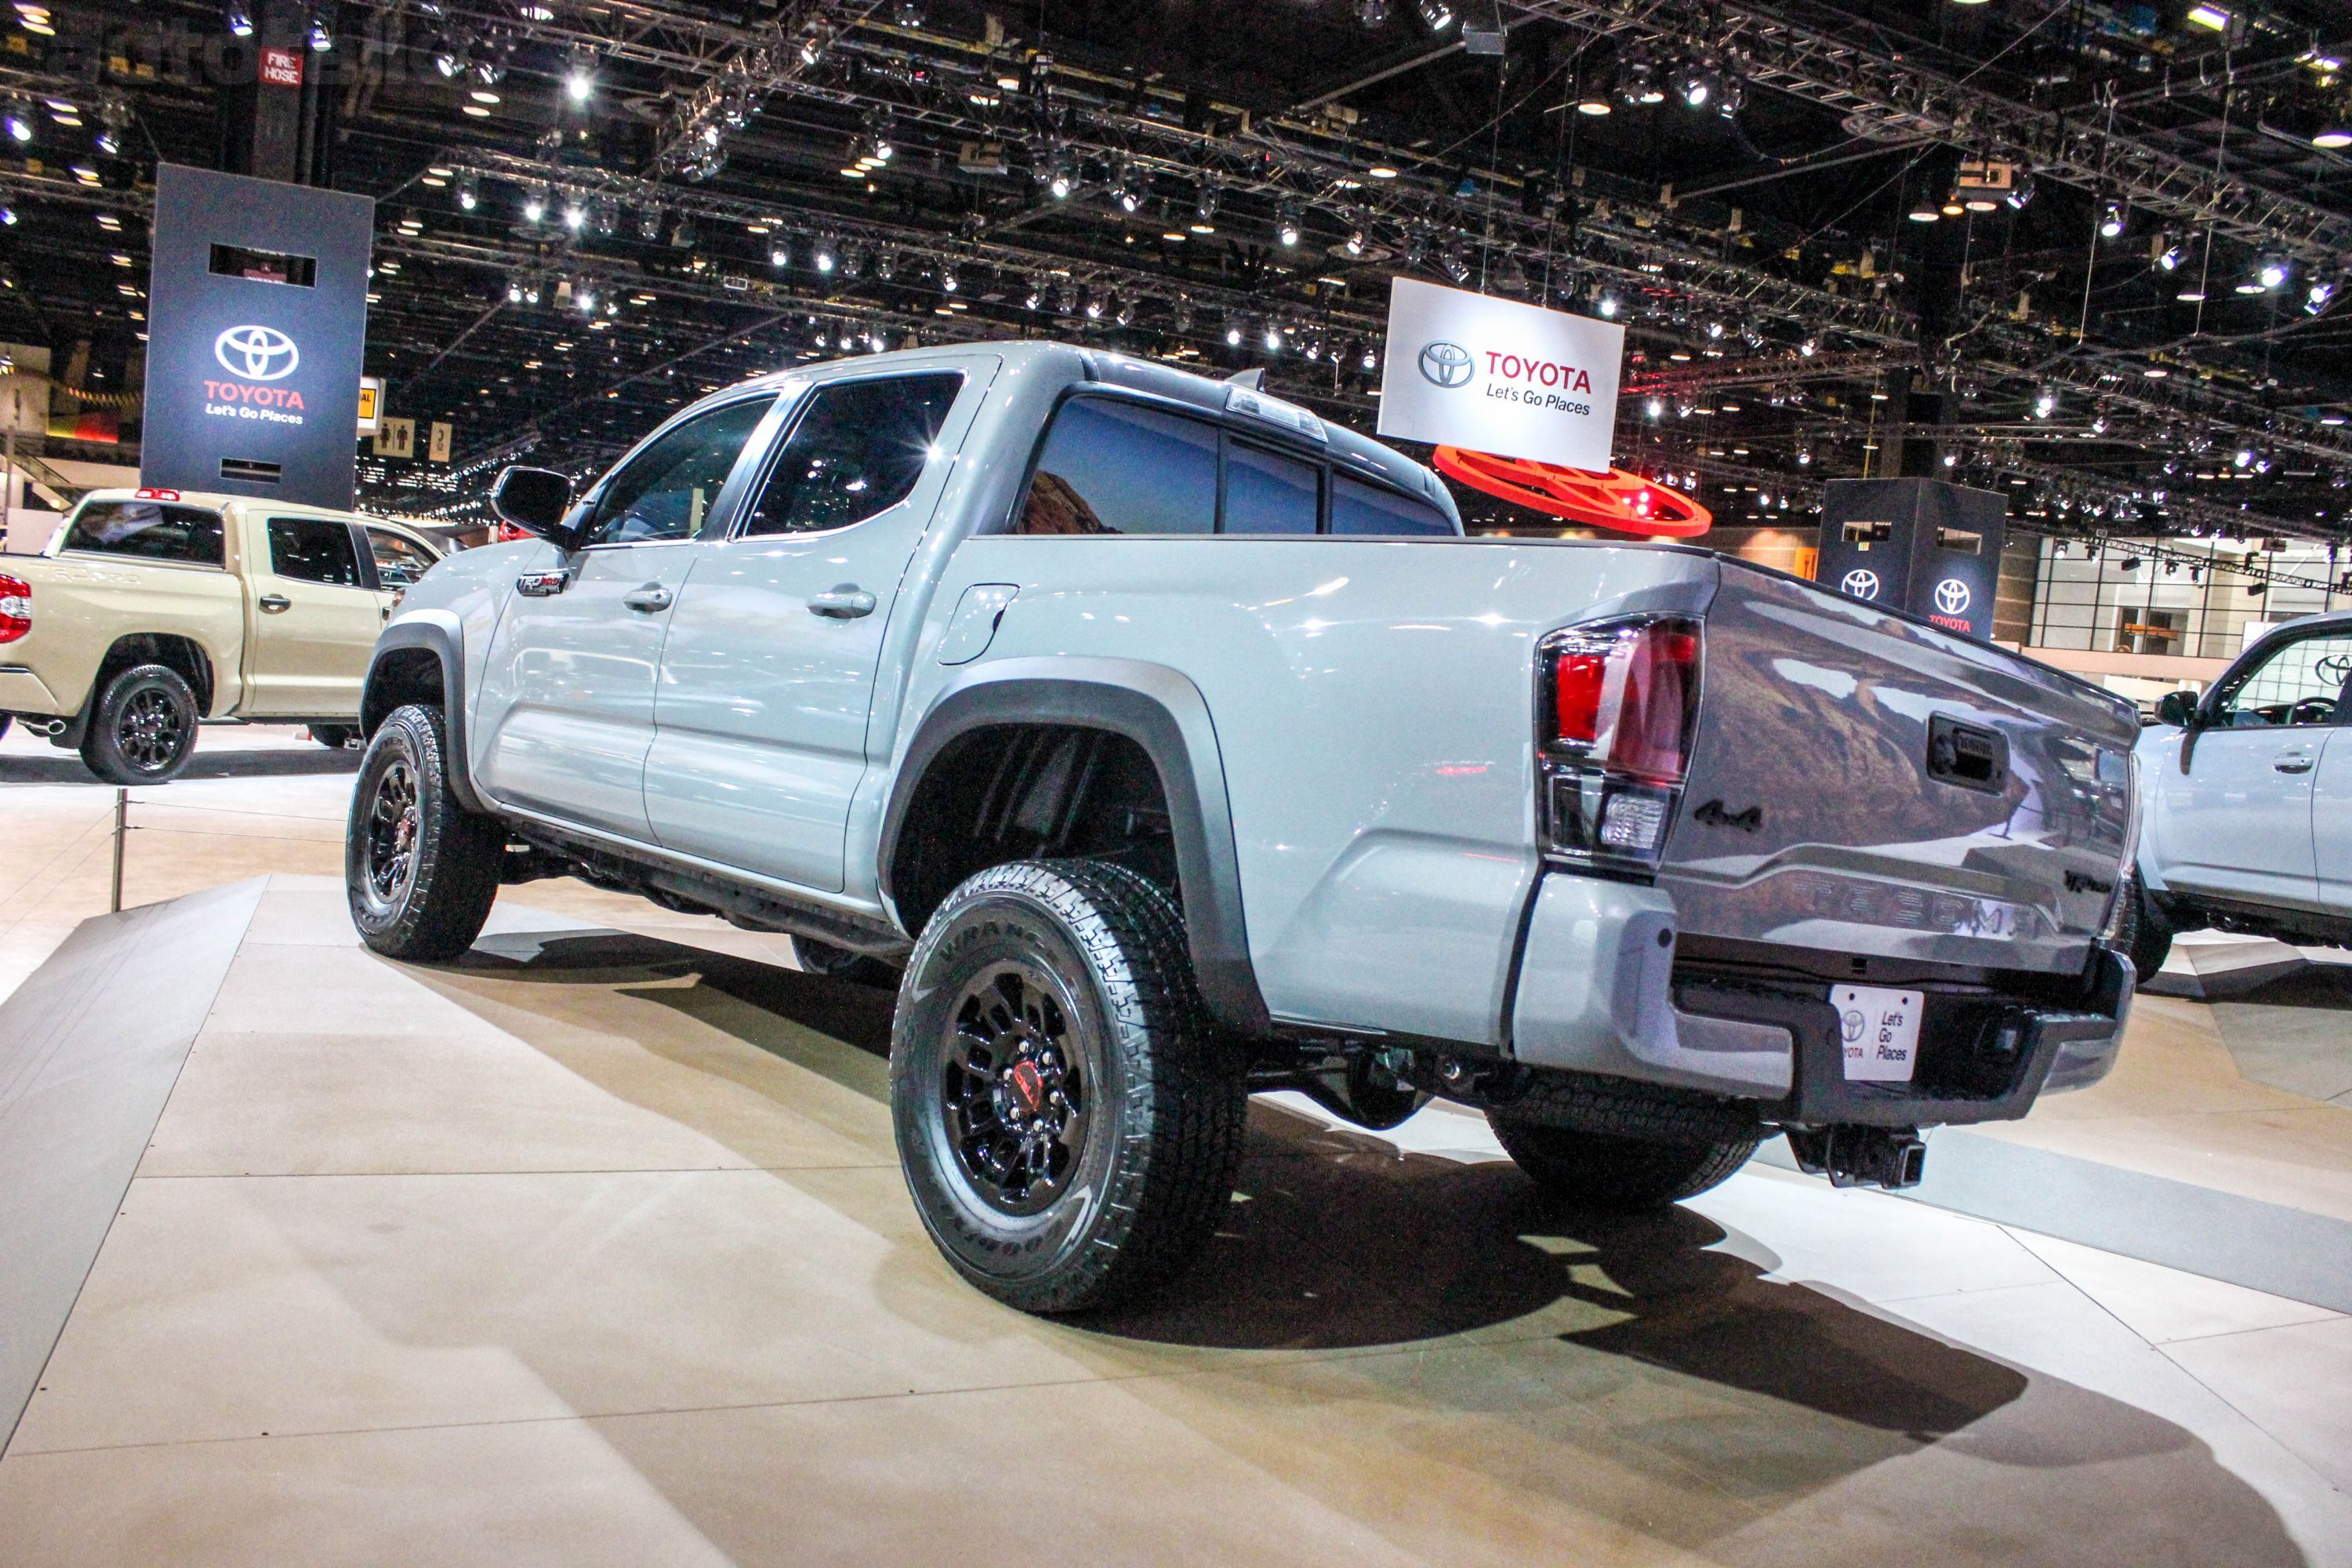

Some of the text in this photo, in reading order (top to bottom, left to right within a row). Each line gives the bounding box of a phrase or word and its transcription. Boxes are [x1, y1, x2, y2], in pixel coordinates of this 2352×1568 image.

[267, 52, 296, 69] FIRE
[264, 66, 298, 84] HOSE
[1486, 350, 1592, 394] TOYOTA
[204, 380, 304, 410] TOYOTA
[361, 394, 371, 402] AL
[1486, 383, 1591, 416] Let's Go Places
[205, 402, 303, 425] Let's Go Places
[1929, 615, 1971, 633] TOYOTA
[1882, 1011, 1904, 1026] Let's
[1878, 1028, 1892, 1043] Go
[1843, 1047, 1864, 1058] YOTA
[1875, 1044, 1907, 1061] Places
